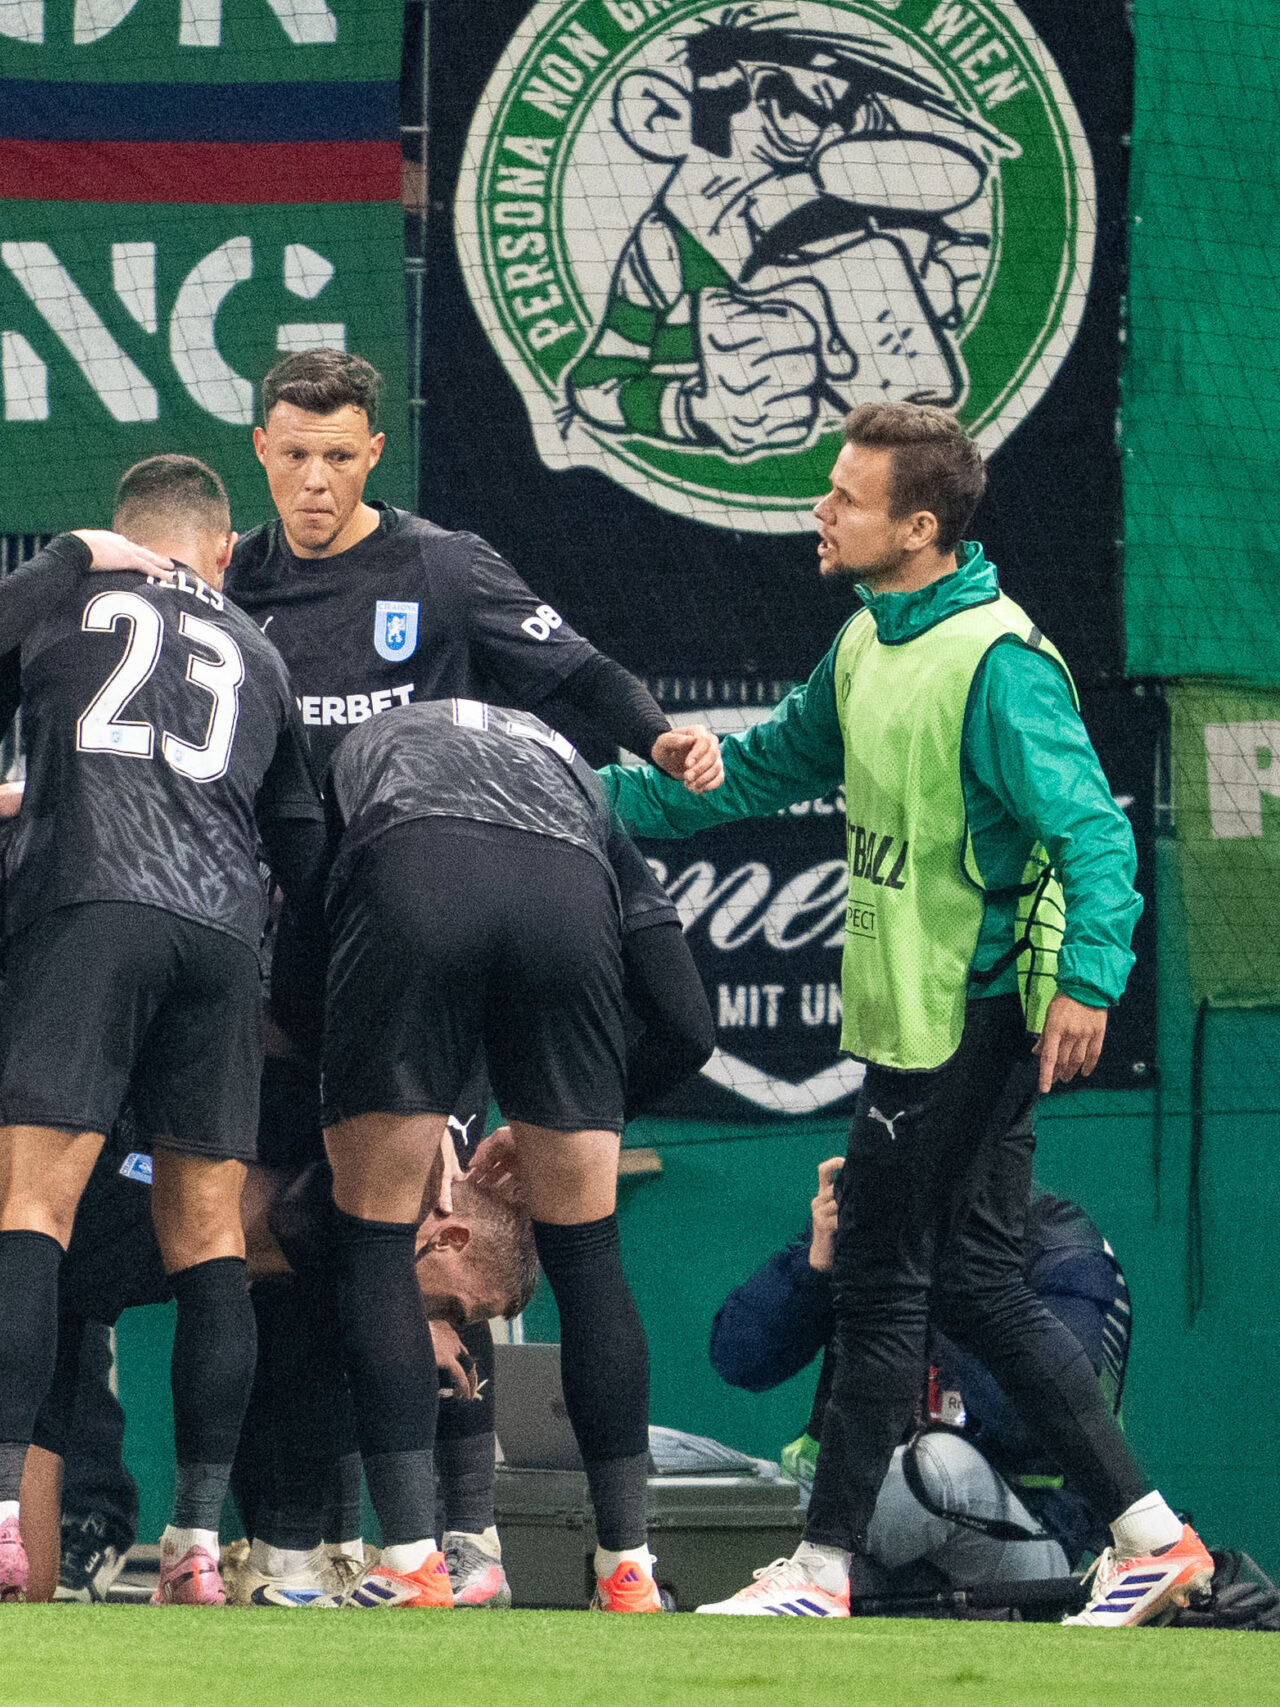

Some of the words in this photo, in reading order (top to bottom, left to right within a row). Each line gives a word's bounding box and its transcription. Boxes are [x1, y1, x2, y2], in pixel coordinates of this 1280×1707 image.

[520, 19, 610, 120] NON
[920, 2, 1028, 110] WIEN
[492, 135, 578, 350] PERSONA
[521, 604, 562, 641] DB
[76, 590, 246, 783] 23
[296, 683, 415, 726] ERBET
[719, 983, 784, 1028] MIT
